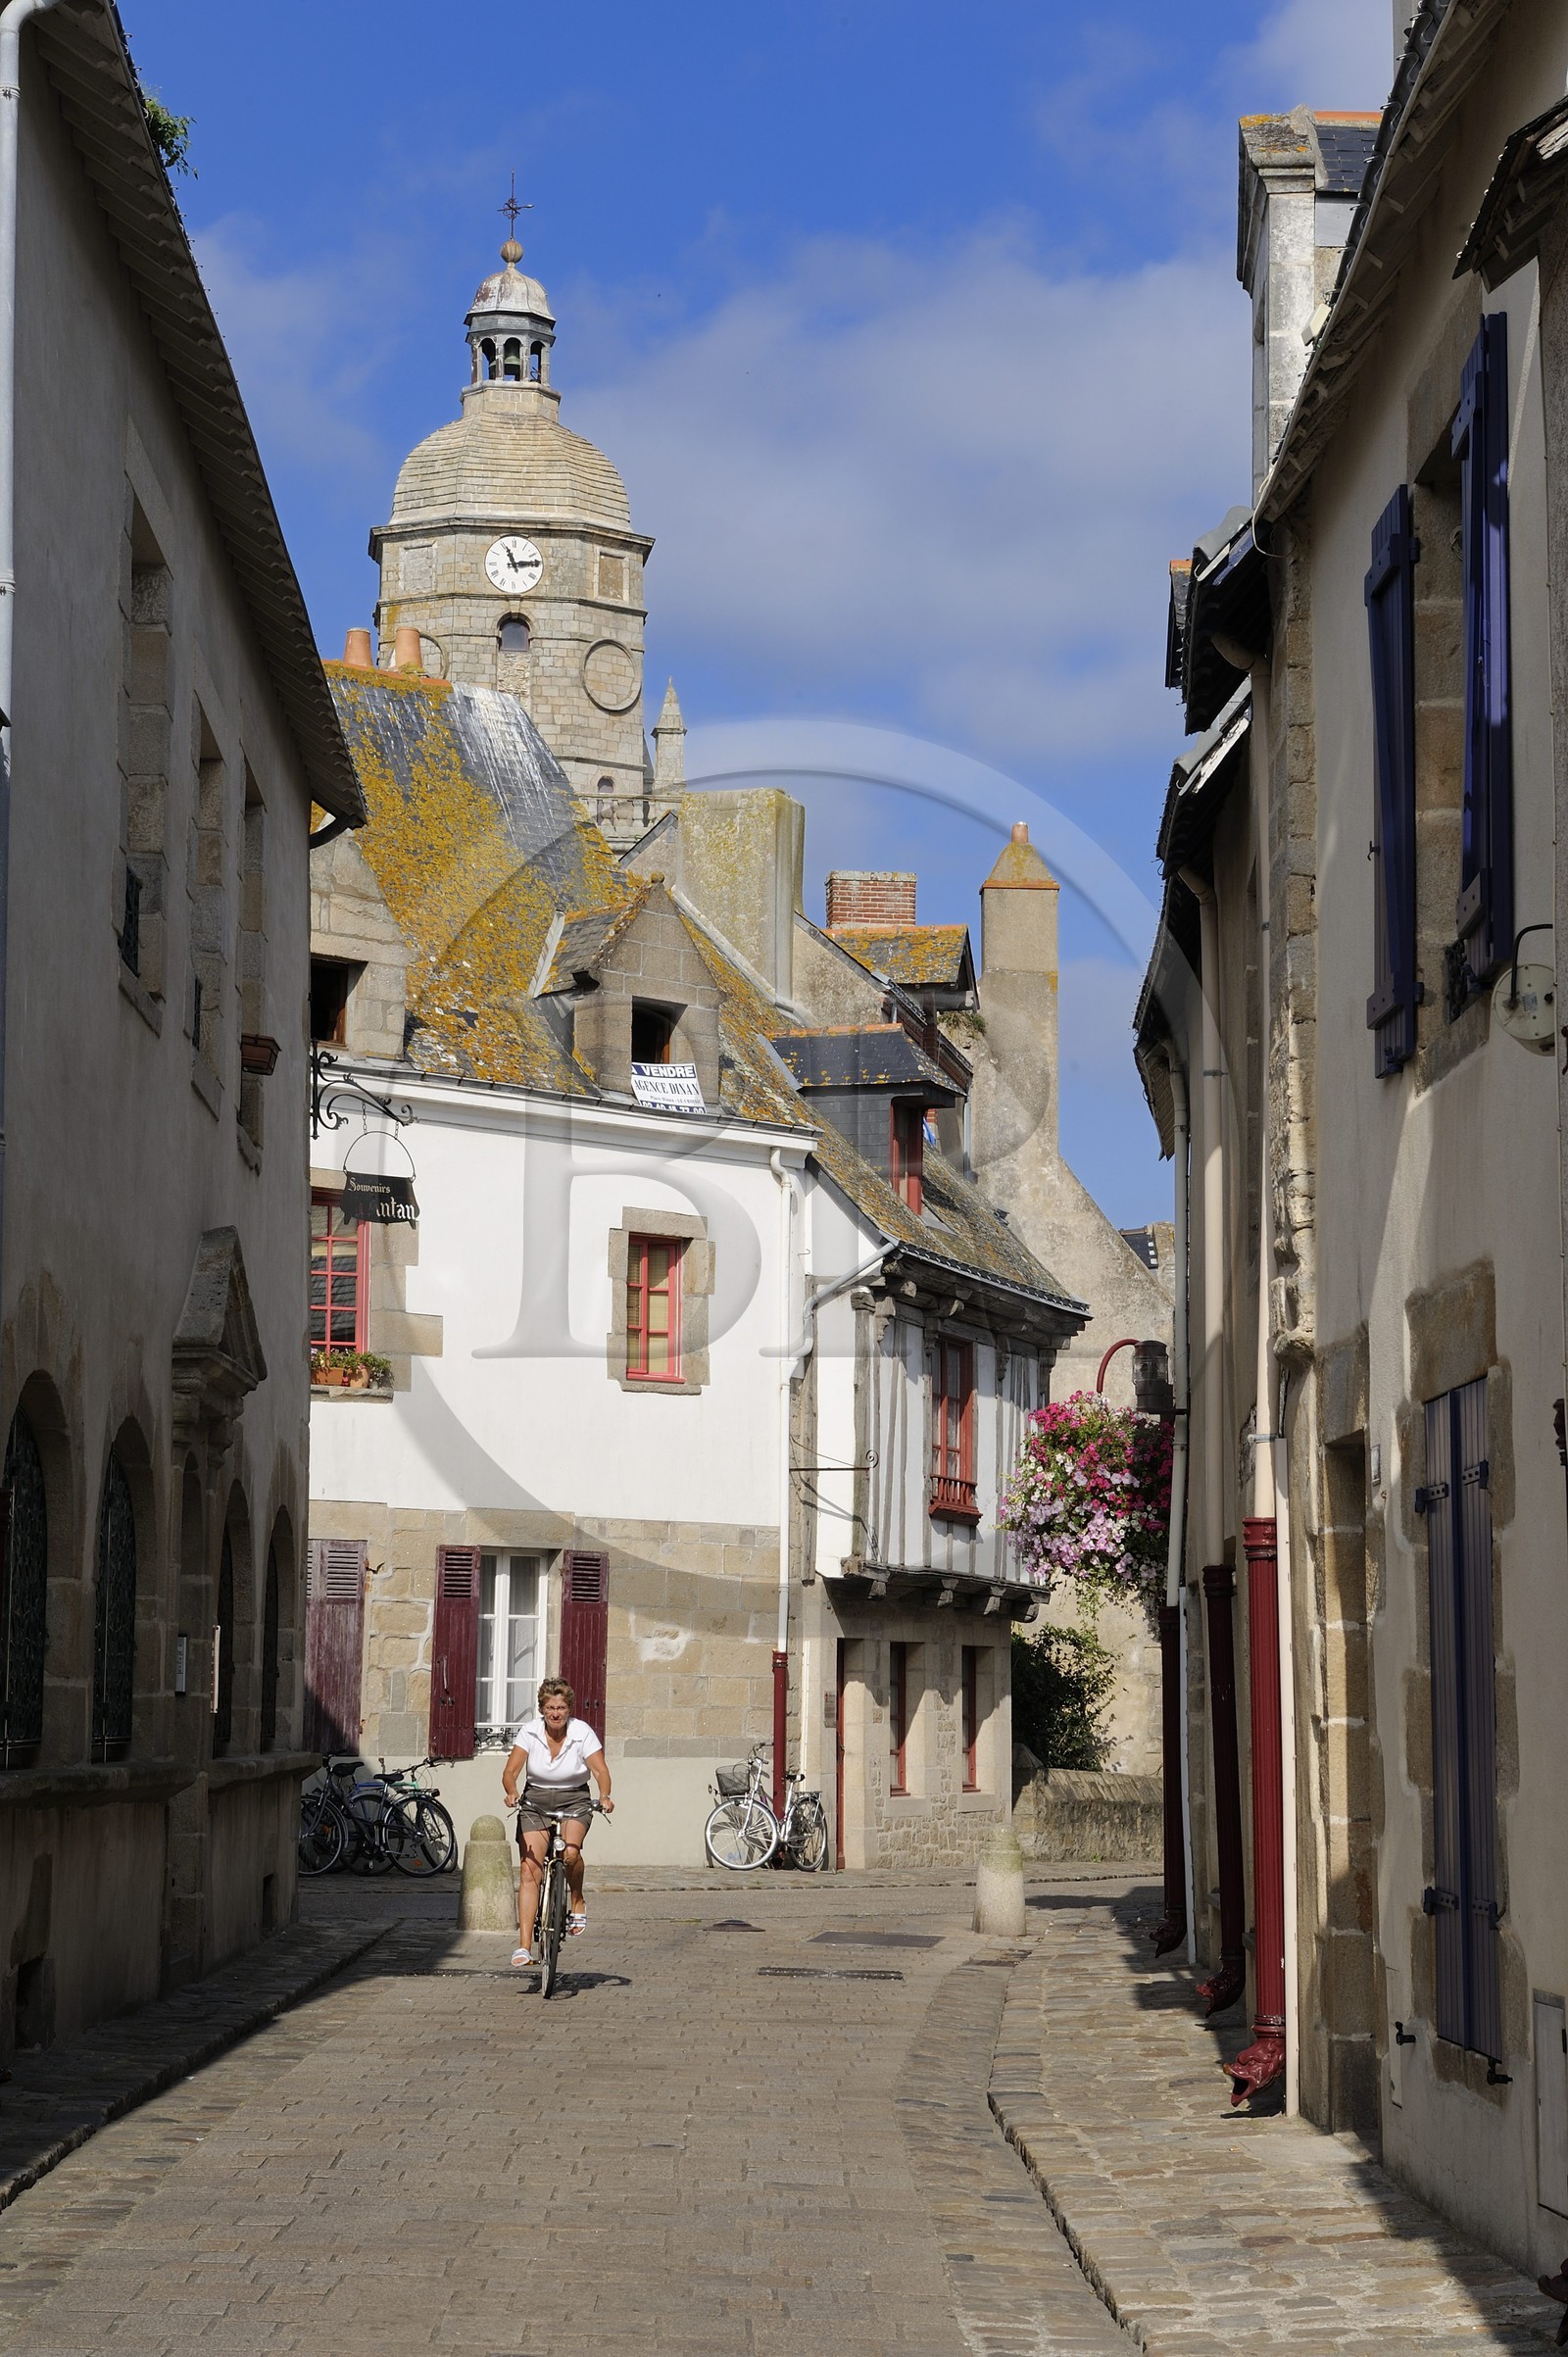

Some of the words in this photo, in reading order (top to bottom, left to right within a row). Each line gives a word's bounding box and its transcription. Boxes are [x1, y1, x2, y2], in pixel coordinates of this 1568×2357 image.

[640, 1065, 695, 1078] VENDRE
[633, 1079, 668, 1094] AGENCE
[668, 1082, 700, 1096] DINAN
[348, 1177, 391, 1194] Souvenirs
